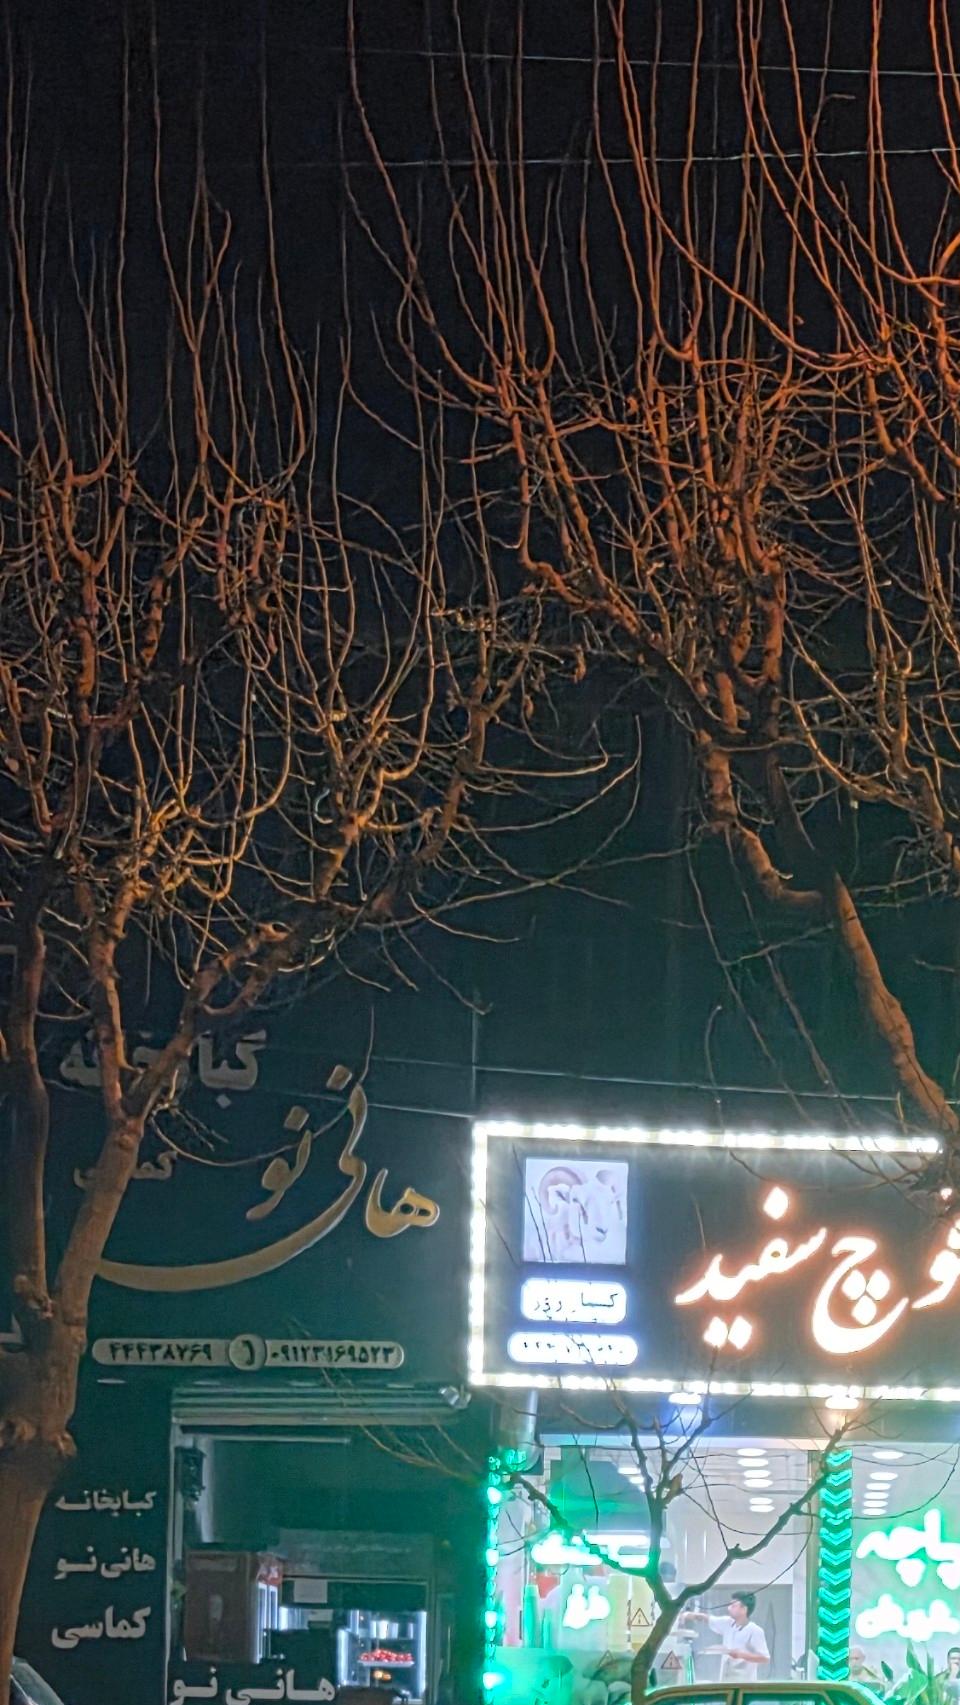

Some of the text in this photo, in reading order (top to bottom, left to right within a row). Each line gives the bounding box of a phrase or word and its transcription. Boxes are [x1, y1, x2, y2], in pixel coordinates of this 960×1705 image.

[676, 1185, 828, 1350] سفید
[55, 1489, 156, 1517] کبابخانه
[53, 1546, 156, 1580] هانی نو
[51, 1605, 151, 1649] کماسی
